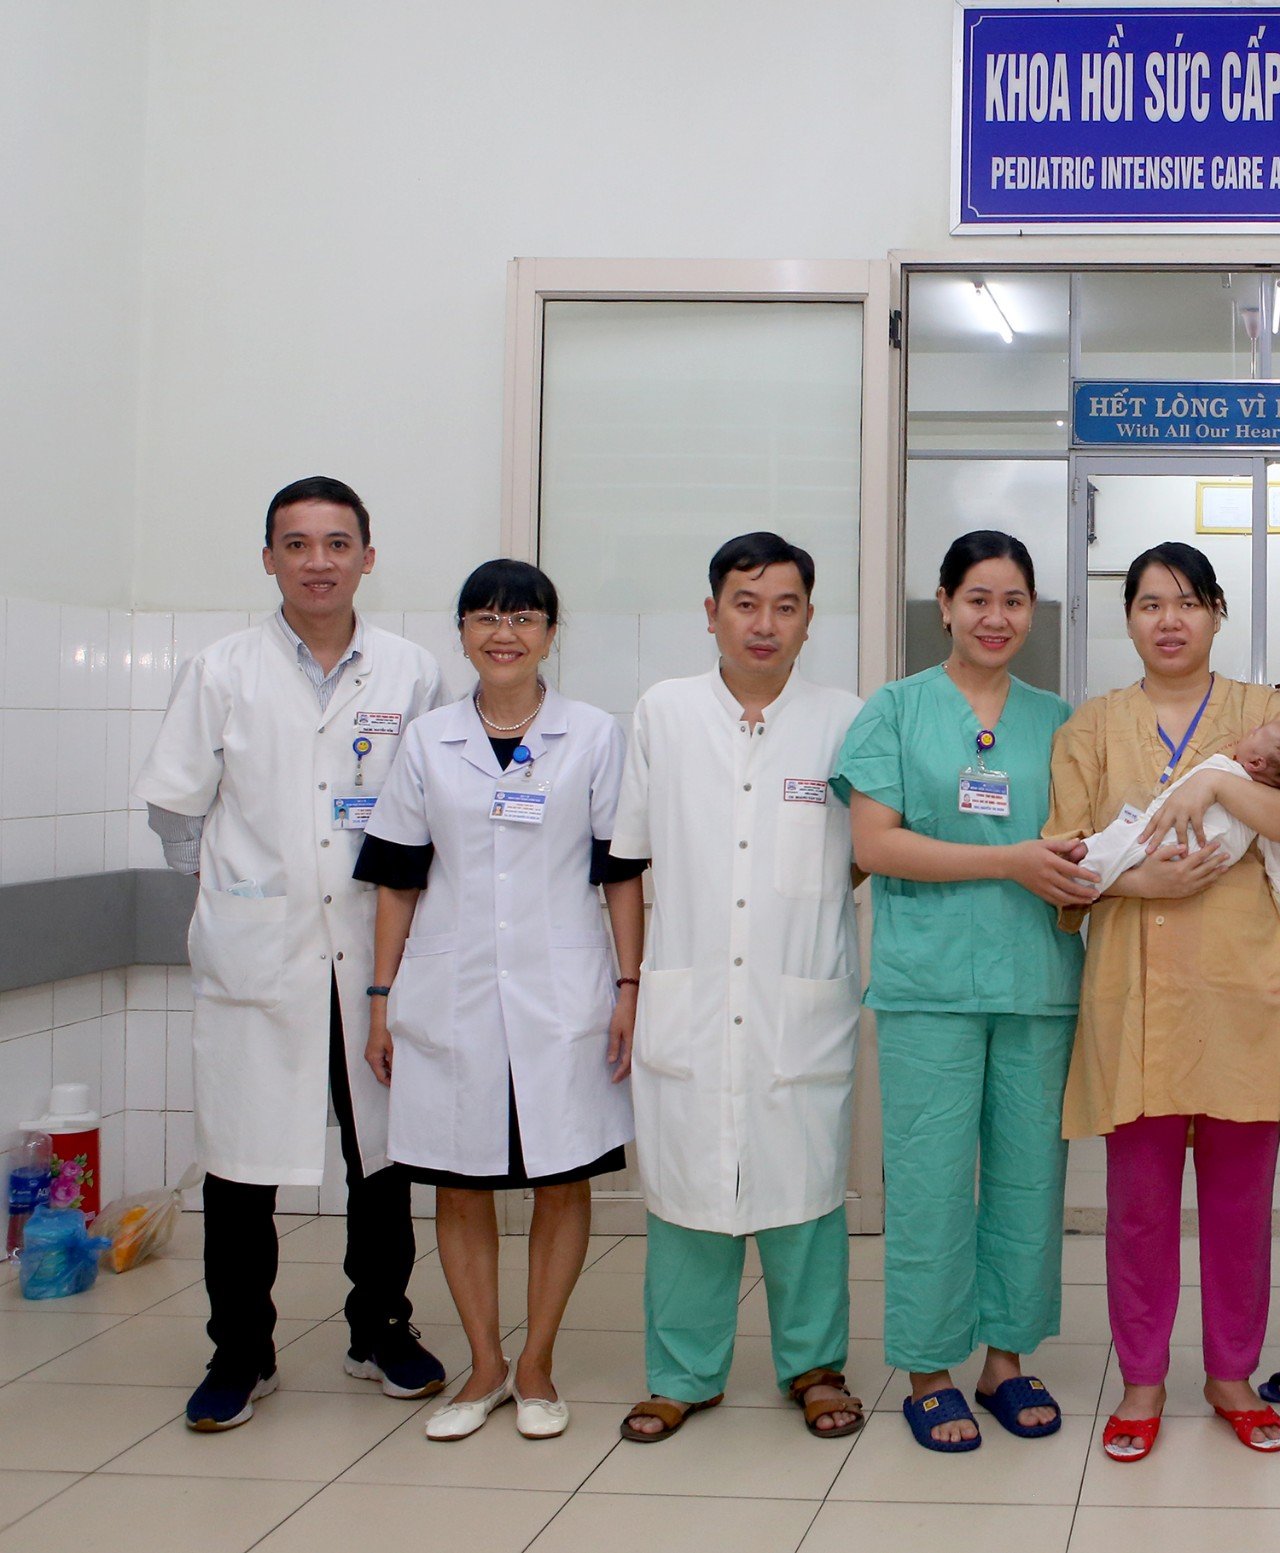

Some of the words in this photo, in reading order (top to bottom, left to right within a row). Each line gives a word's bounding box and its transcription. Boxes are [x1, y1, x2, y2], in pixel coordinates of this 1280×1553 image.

[984, 52, 1071, 122] KHOA
[1080, 23, 1134, 122] HỒI
[1144, 32, 1211, 122] SỨC
[991, 156, 1095, 190] PEDIATRIC
[1101, 156, 1205, 190] INTENSIVE
[1211, 156, 1264, 190] CARE
[1089, 388, 1146, 417] HẾT
[1155, 392, 1229, 418] LÒNG
[1237, 393, 1266, 418] VÌ
[1116, 423, 1159, 438] With
[1165, 424, 1190, 438] All
[1196, 424, 1230, 438] Our
